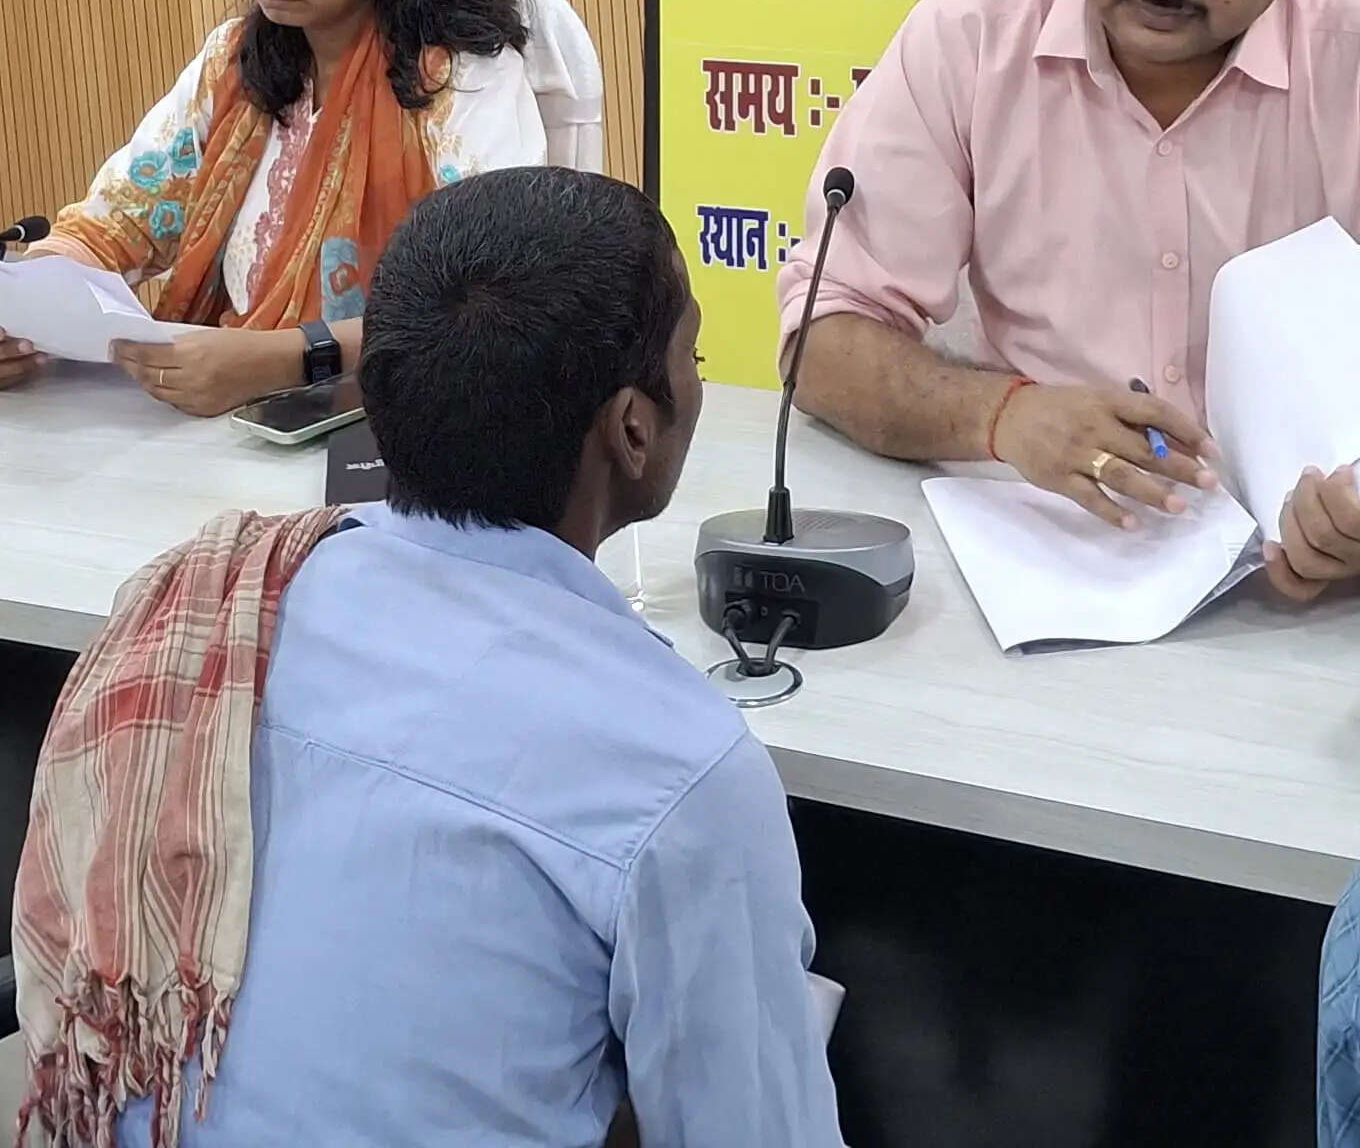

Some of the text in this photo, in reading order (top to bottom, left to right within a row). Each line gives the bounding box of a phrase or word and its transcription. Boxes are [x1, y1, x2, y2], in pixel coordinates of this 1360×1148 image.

[702, 59, 799, 136] समय
[697, 205, 769, 270] स्थान
[759, 570, 806, 593] TOA
